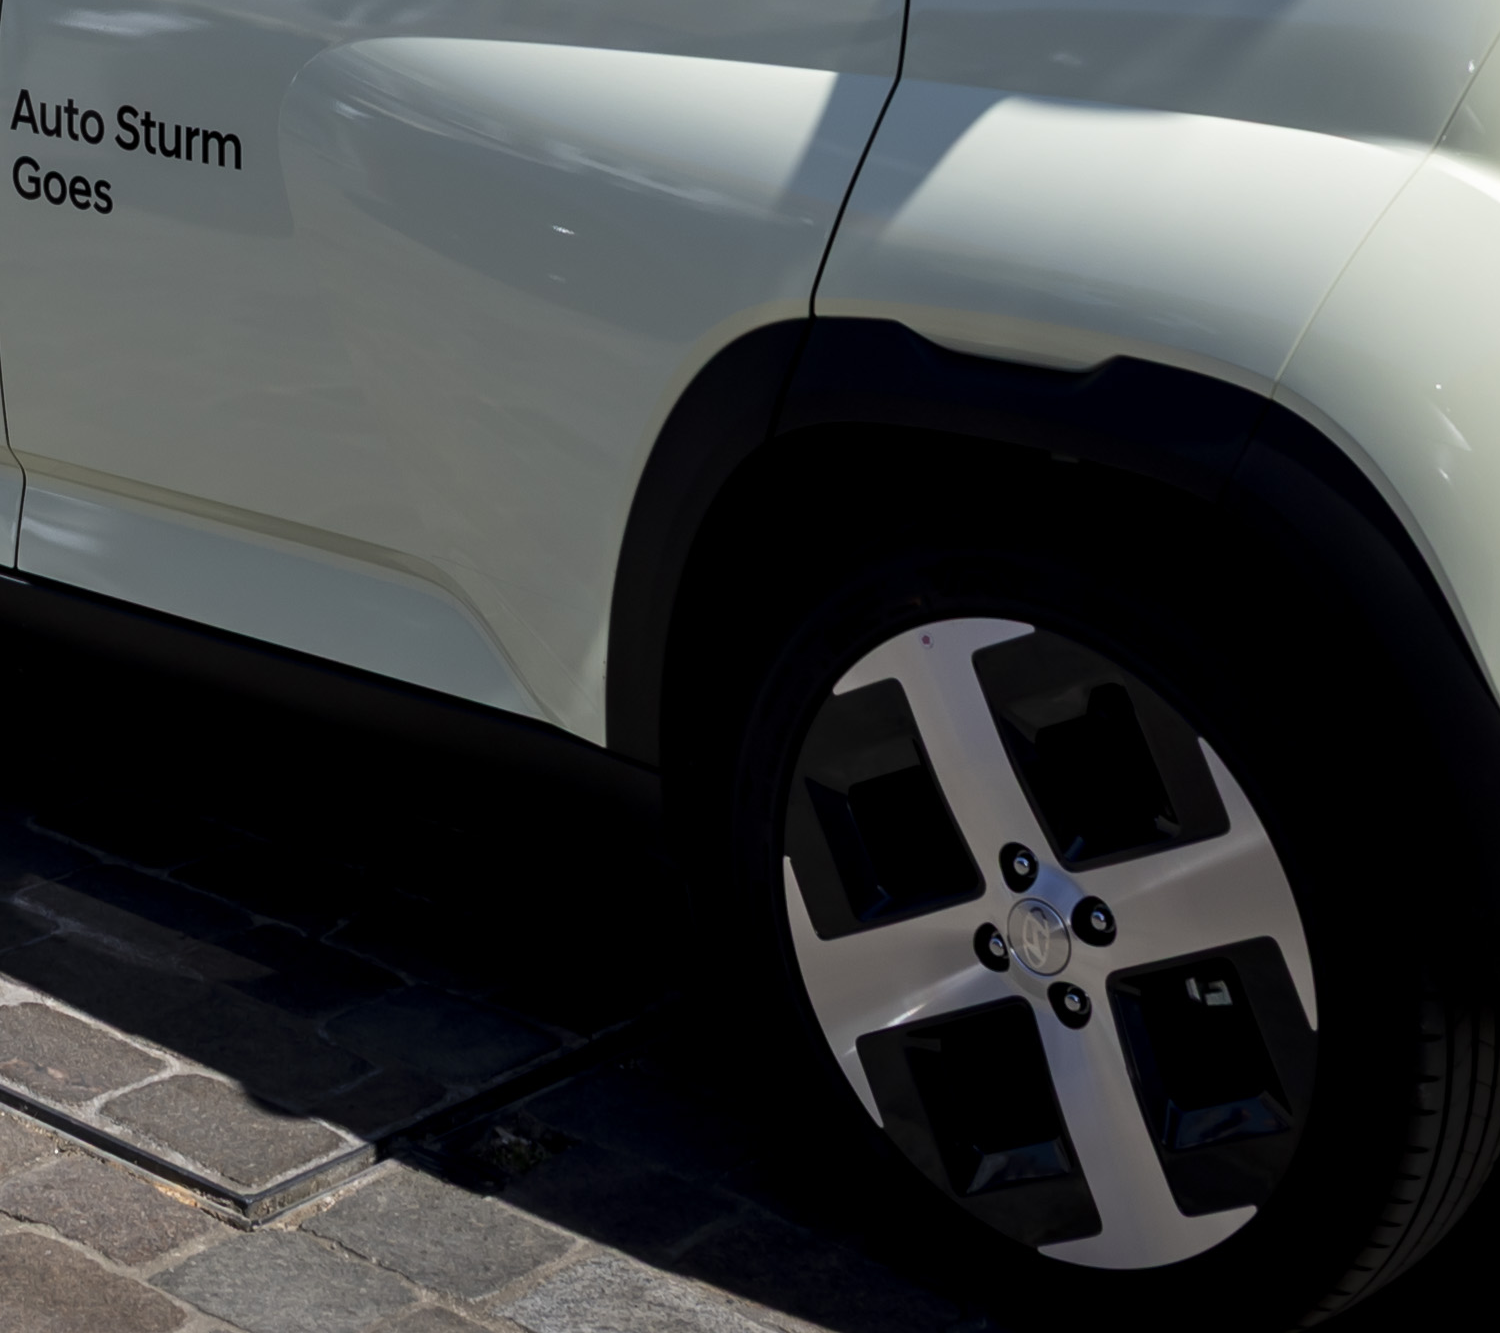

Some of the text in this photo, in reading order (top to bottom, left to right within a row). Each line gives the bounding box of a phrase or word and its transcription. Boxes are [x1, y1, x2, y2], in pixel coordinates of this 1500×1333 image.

[10, 89, 243, 171] Auto Sturm
[11, 156, 114, 215] Goes
